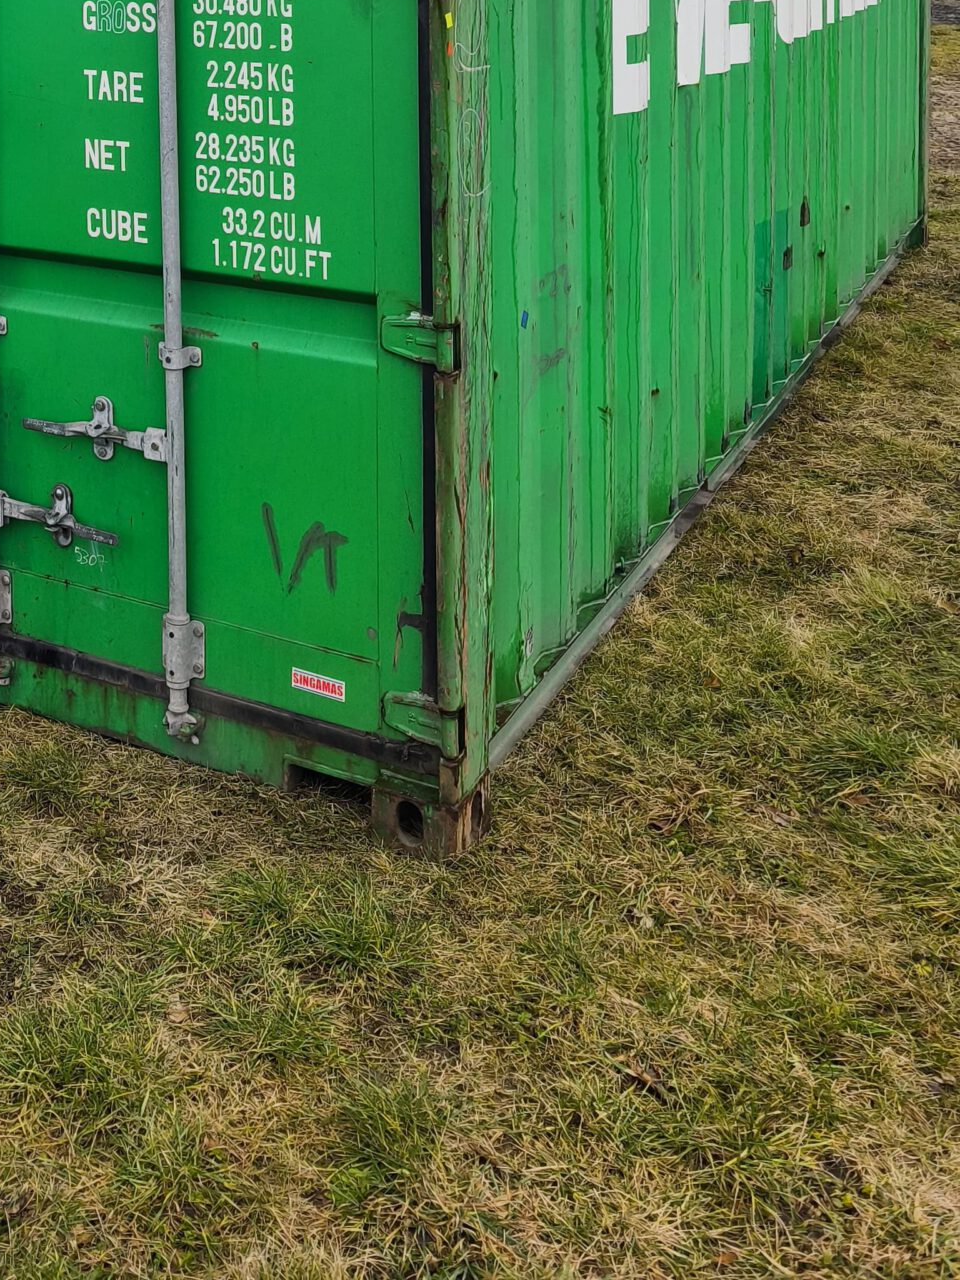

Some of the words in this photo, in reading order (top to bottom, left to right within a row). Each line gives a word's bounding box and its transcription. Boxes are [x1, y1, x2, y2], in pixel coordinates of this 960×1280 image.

[82, 0, 157, 34] GROSS
[192, 20, 262, 50] 67.200
[83, 68, 144, 103] TARE
[206, 60, 263, 90] 2.245
[267, 63, 294, 92] KG
[207, 94, 263, 124] 4.950
[268, 96, 294, 127] LB
[84, 138, 130, 172] NET
[195, 131, 264, 164] 28.235
[269, 136, 295, 167] KG
[195, 166, 265, 198] 62.250
[269, 170, 296, 202] LB
[86, 207, 148, 244] CUBE
[222, 206, 266, 239] 33.2
[212, 238, 266, 272] 1.172
[292, 672, 344, 697] SINGAMAS
